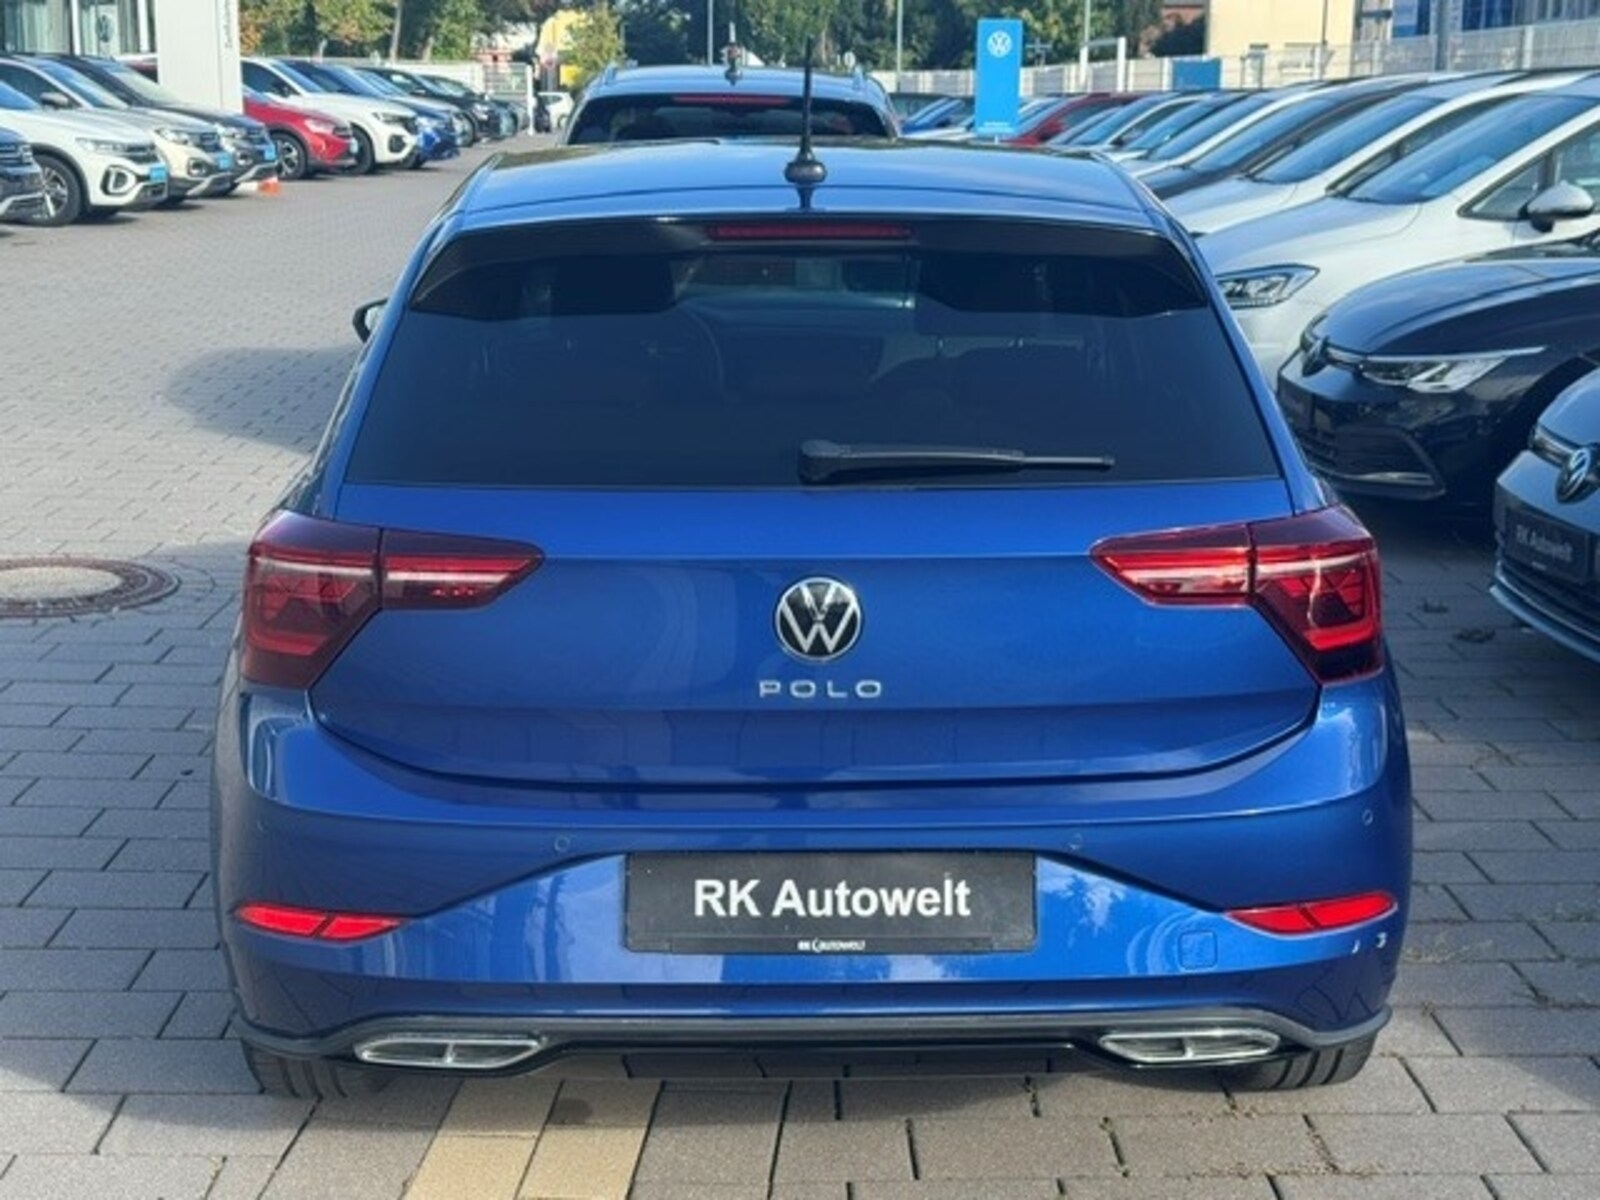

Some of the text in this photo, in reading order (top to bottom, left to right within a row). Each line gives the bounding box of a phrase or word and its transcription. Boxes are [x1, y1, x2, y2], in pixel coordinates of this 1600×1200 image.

[759, 680, 882, 698] POLO
[694, 877, 971, 918] RK Autowelt
